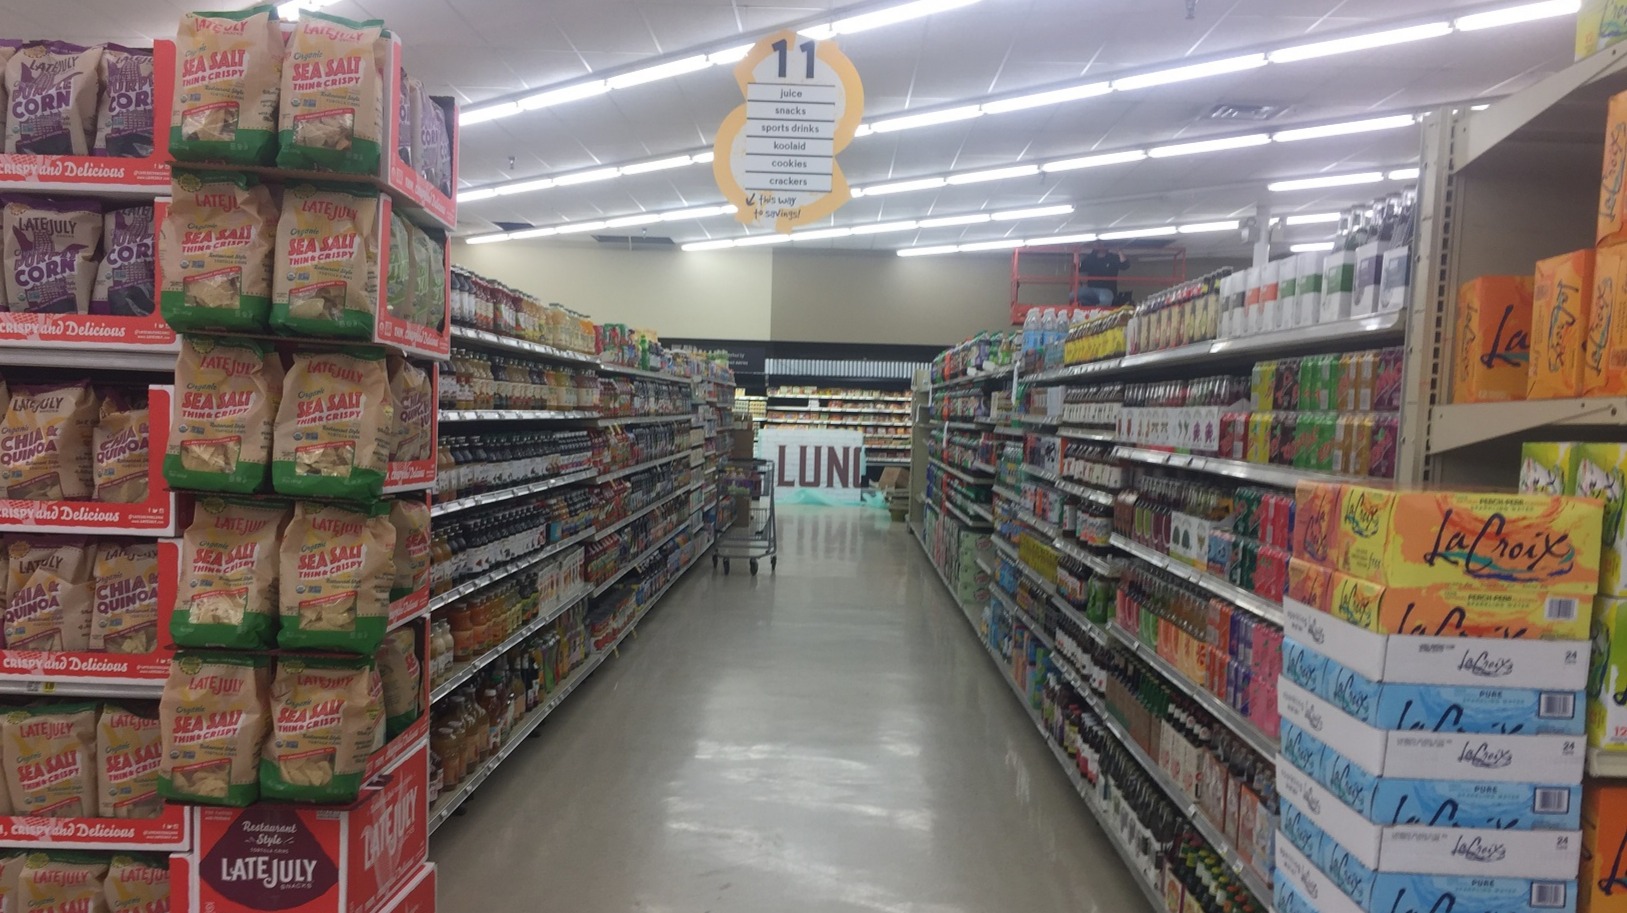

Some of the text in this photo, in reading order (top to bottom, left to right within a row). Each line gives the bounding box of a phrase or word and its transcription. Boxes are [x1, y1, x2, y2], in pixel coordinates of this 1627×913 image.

[183, 49, 245, 78] SEA SALT
[294, 50, 322, 60] Organic
[772, 39, 815, 79] 11
[292, 56, 361, 82] SEA SALT
[323, 77, 360, 87] CRISPY
[780, 89, 802, 98] juice
[12, 91, 71, 119] CORN
[109, 91, 153, 115] COR
[775, 106, 806, 115] snacks
[762, 124, 819, 133] sports drinks
[774, 141, 806, 150] koolaid
[40, 161, 62, 176] and
[65, 161, 125, 179] Delicious
[772, 160, 807, 168] cookies
[769, 178, 807, 186] crackers
[759, 194, 796, 206] this way
[755, 209, 801, 219] to savings!
[183, 225, 252, 245] SEA SALT
[290, 228, 319, 236] Organic
[288, 233, 356, 256] SEA SALT
[107, 242, 153, 266] COR
[317, 250, 354, 260] CRISPY
[15, 258, 76, 287] CORN
[41, 321, 64, 336] and
[66, 321, 125, 338] Delicious
[187, 382, 217, 391] Organic
[182, 391, 254, 410] SEA SALT
[297, 392, 363, 418] SEA SALT
[214, 408, 249, 418] CRISPY
[325, 410, 361, 420] CRISPY
[1, 425, 44, 452] CHIA
[0, 439, 57, 465] QUINOA
[36, 505, 58, 520] and
[60, 505, 120, 522] Delicious
[1424, 508, 1569, 573] LaCroix
[193, 542, 258, 566] SEA SALT
[298, 544, 364, 571] SEA SALT
[329, 560, 363, 573] CRISPY
[97, 575, 146, 600] CHIA
[4, 597, 60, 624] QUINOA
[1457, 648, 1514, 677] LaCroix
[1565, 651, 1577, 660] 24
[41, 658, 66, 669] and
[68, 657, 128, 672] Delicious
[1479, 691, 1502, 699] PURE
[278, 700, 345, 723] SEA SALT
[172, 709, 243, 734] SEA SALT
[203, 727, 238, 738] CRISPY
[1458, 741, 1512, 768] LaCroix
[1563, 742, 1575, 751] 24
[17, 751, 77, 782] SEA SALT
[106, 743, 162, 773] SEA SAL
[1474, 786, 1498, 794] PURE
[54, 823, 75, 836] and
[77, 823, 135, 837] Delicious
[242, 820, 297, 835] Restaurant
[257, 834, 282, 846] Style
[1451, 835, 1506, 862] LaCroix
[1557, 836, 1568, 845] 24
[1471, 880, 1495, 888] PURE
